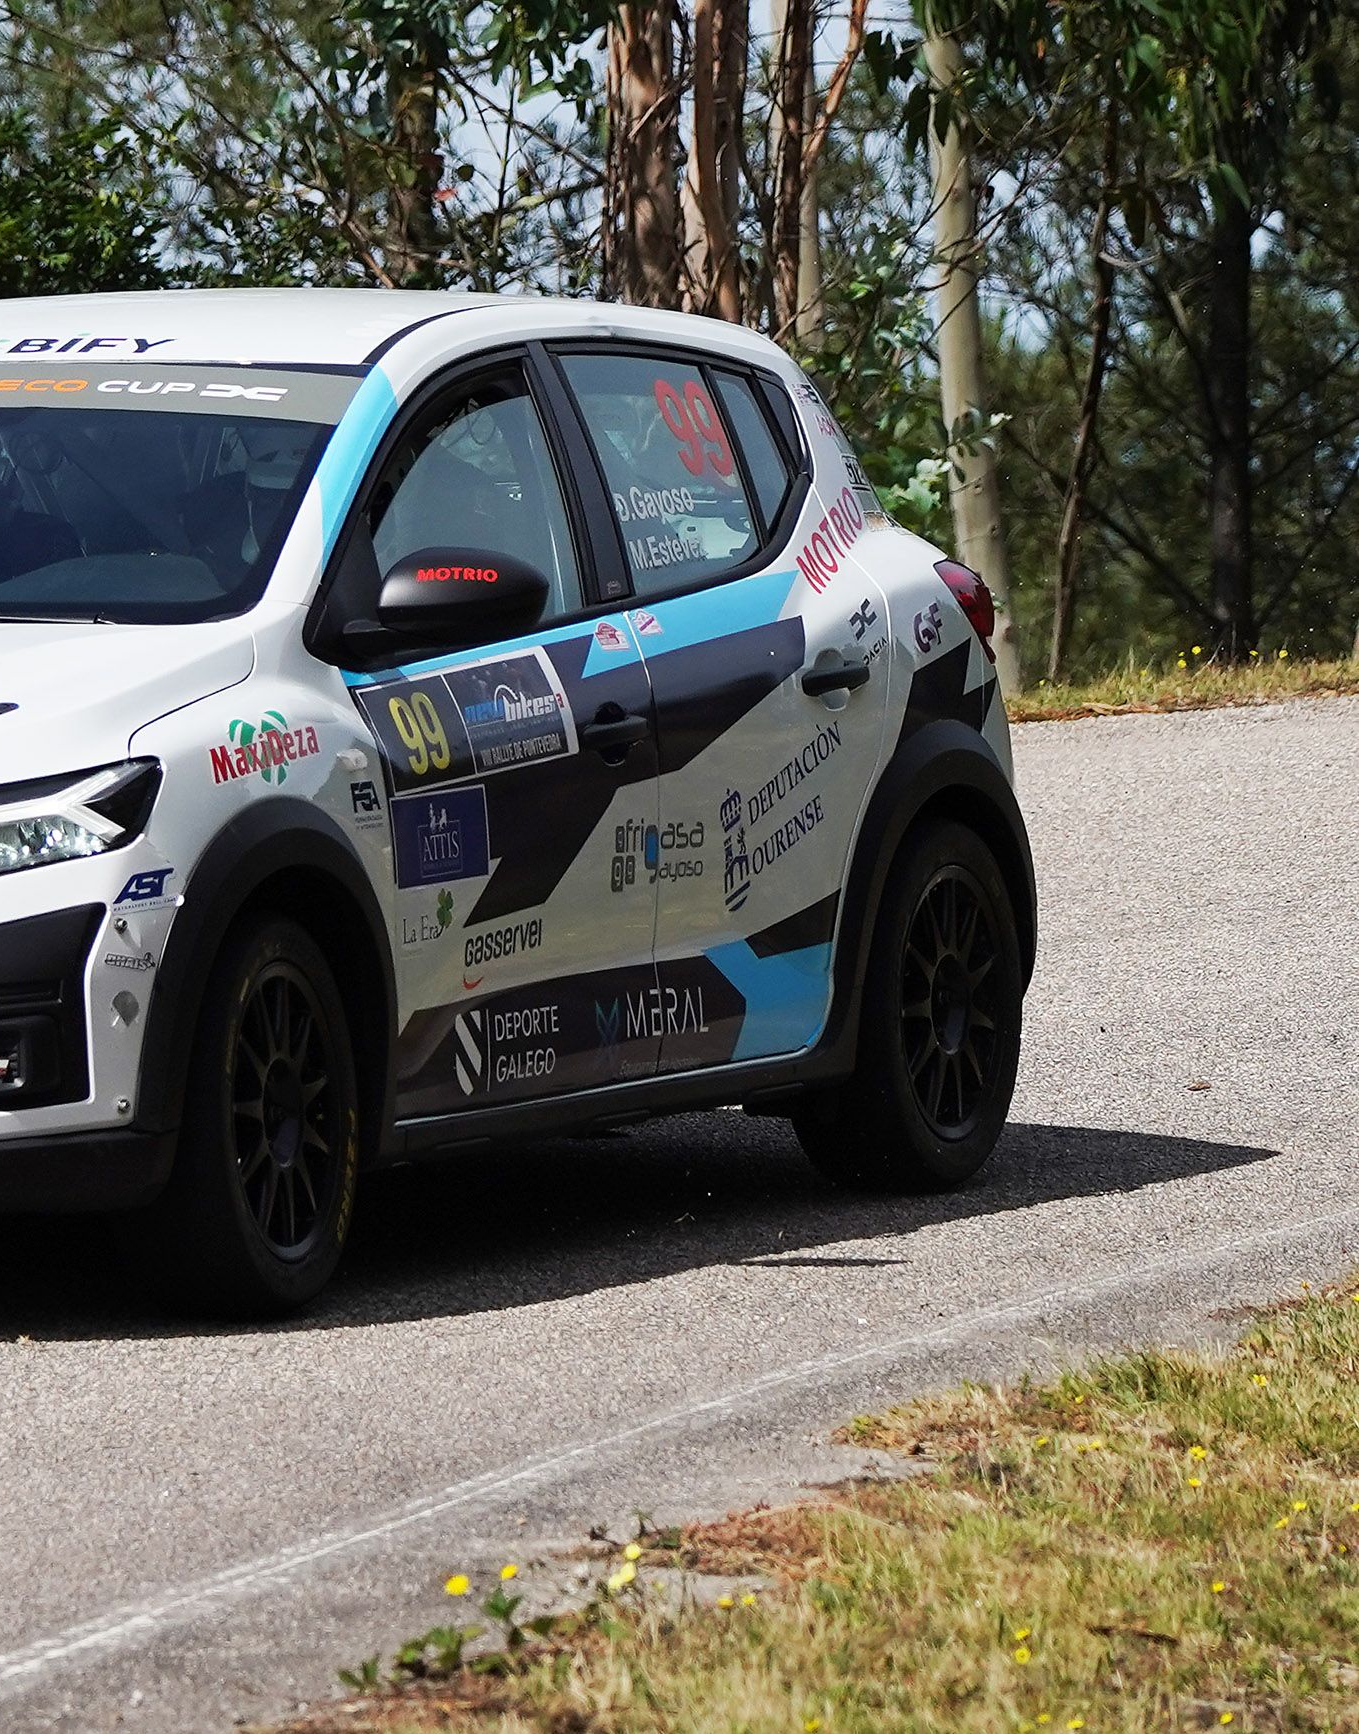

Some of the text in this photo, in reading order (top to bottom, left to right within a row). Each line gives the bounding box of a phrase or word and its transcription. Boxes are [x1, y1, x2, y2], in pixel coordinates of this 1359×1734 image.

[96, 379, 197, 396] CUP
[653, 378, 735, 476] 99
[795, 486, 864, 594] MOTRIO
[416, 566, 499, 583] MOTRIO
[502, 690, 556, 722] bikes
[387, 691, 452, 776] 99
[209, 721, 320, 786] MaxiDeza
[747, 719, 843, 826] DEPUTACIÓN
[423, 830, 460, 862] ATTIS
[752, 794, 825, 876] OURENSE
[403, 918, 417, 945] La
[493, 1004, 561, 1043] DEPORTE
[495, 1046, 557, 1083] GALEGO
